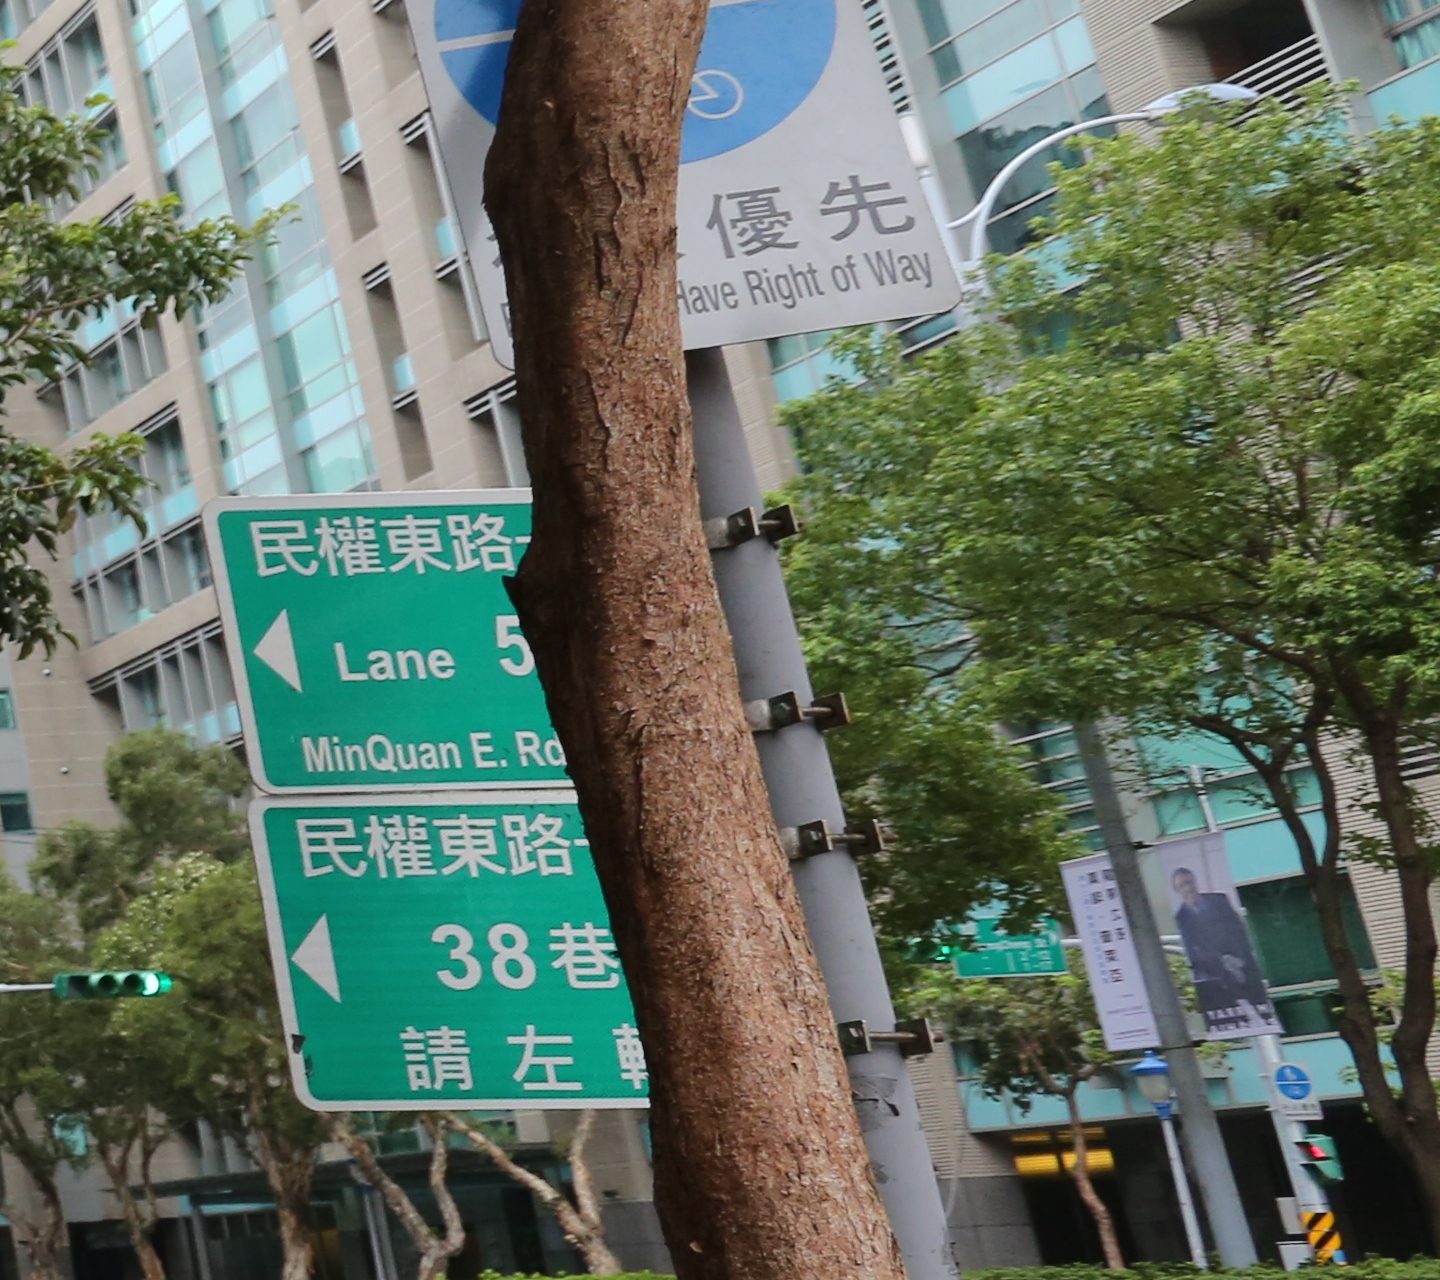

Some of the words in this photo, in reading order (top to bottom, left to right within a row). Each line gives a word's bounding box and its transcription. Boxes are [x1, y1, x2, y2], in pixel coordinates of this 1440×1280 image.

[743, 262, 825, 310] Right
[832, 254, 861, 293] of
[863, 249, 933, 288] Way
[249, 513, 532, 578] 民權東路
[335, 641, 455, 683] Lane
[302, 732, 462, 774] MinQuan
[472, 732, 507, 769] E.
[296, 812, 590, 879] 民權東路
